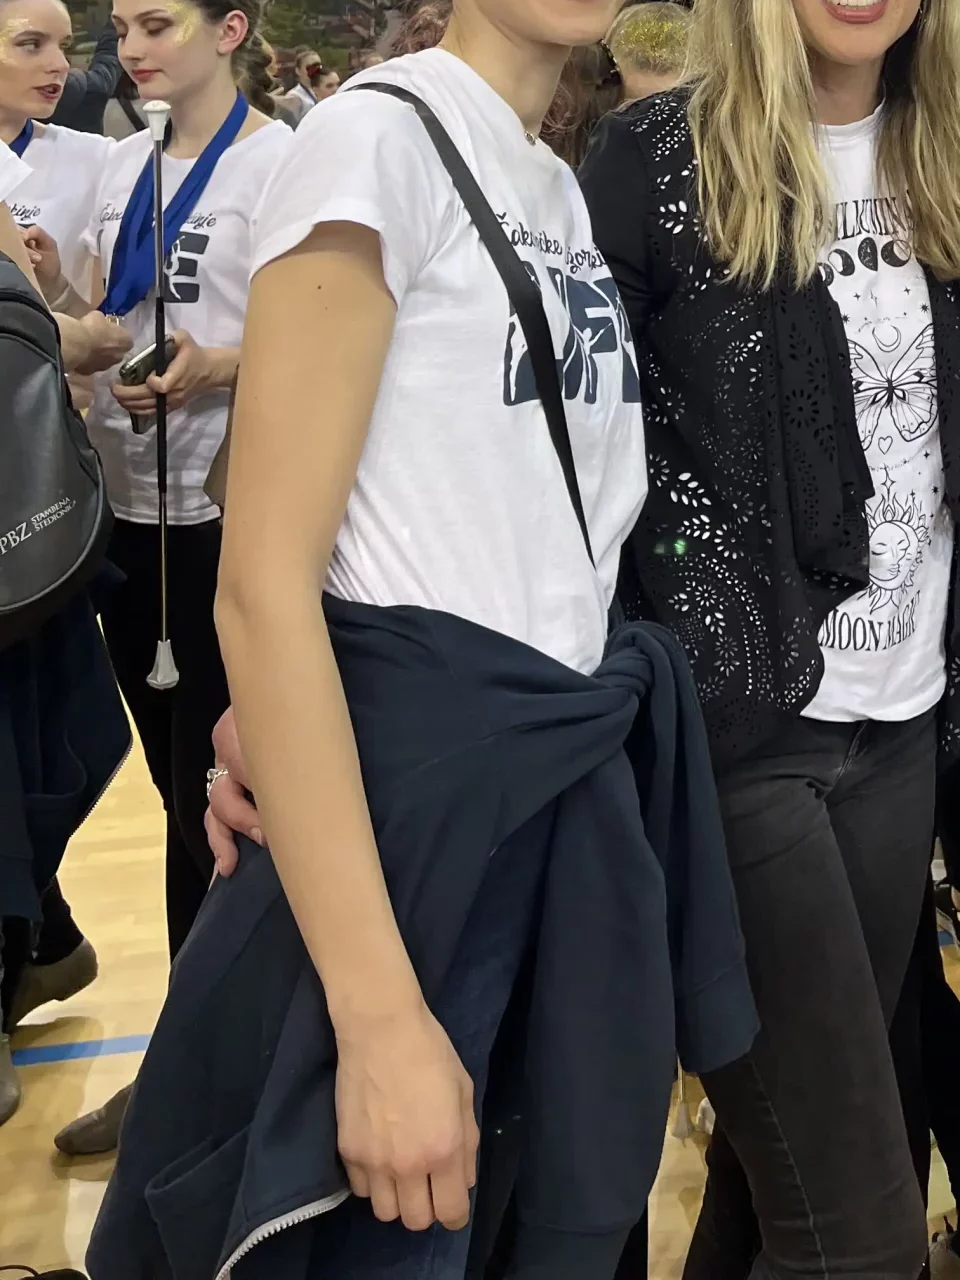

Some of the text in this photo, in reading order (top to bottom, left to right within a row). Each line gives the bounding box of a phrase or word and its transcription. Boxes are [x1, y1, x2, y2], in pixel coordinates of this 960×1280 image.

[31, 497, 71, 524] STAMBENA
[0, 522, 32, 555] PBZ
[819, 608, 884, 652] MOON
